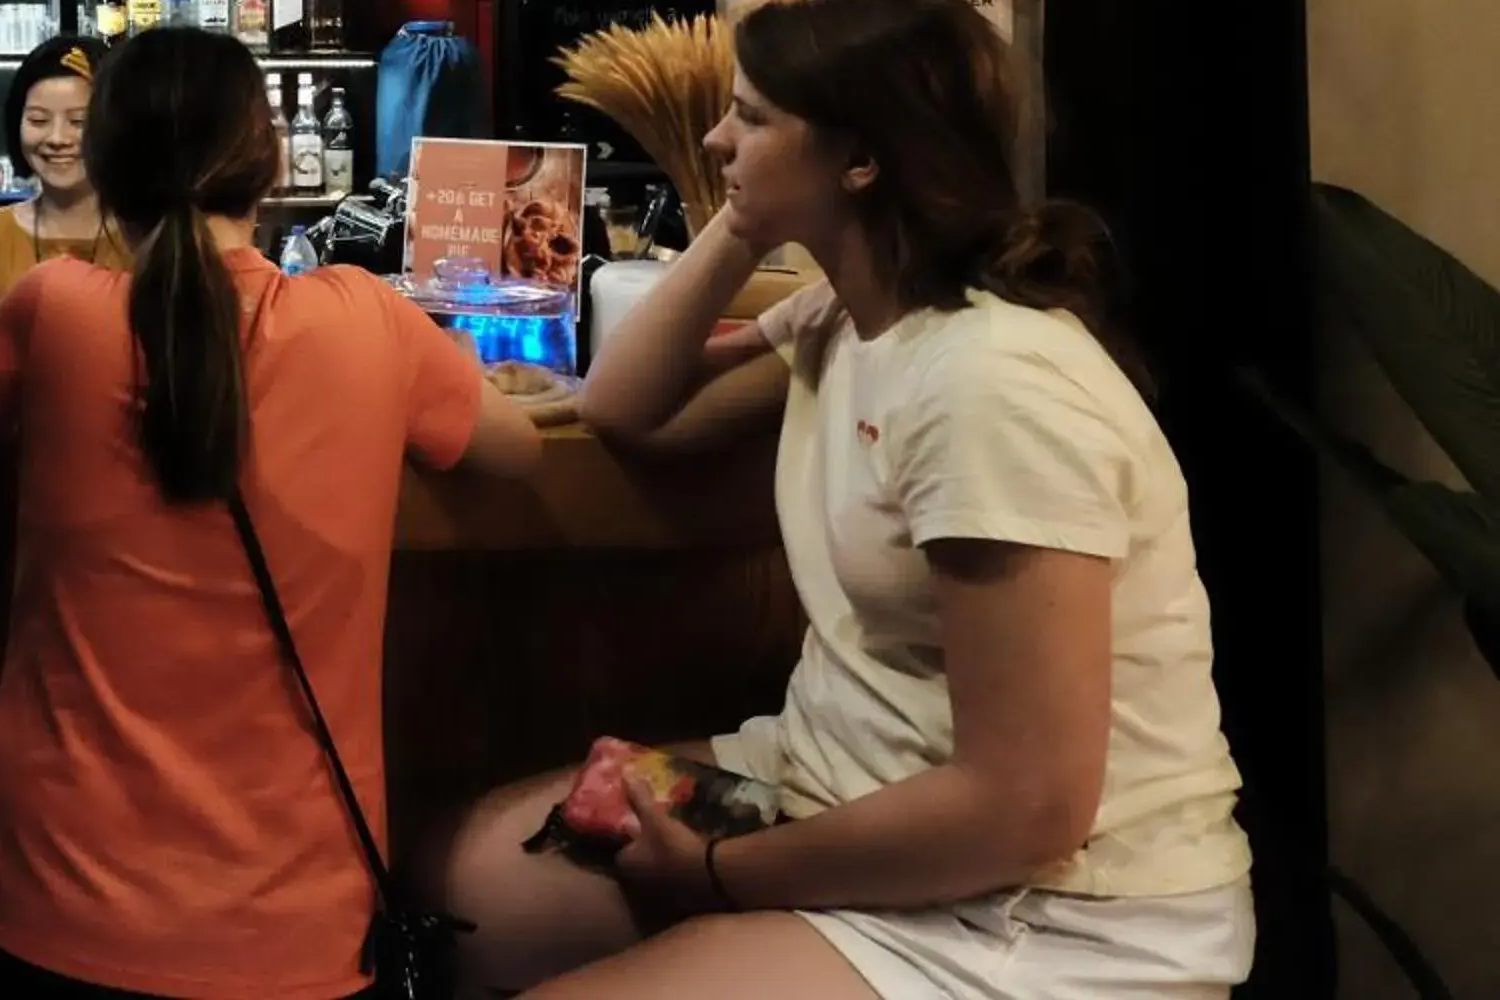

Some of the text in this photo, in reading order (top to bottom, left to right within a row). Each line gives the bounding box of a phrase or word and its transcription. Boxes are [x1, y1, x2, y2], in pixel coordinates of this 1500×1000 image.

[469, 190, 495, 207] GET
[453, 207, 464, 223] A
[421, 225, 500, 244] HOMEMADE
